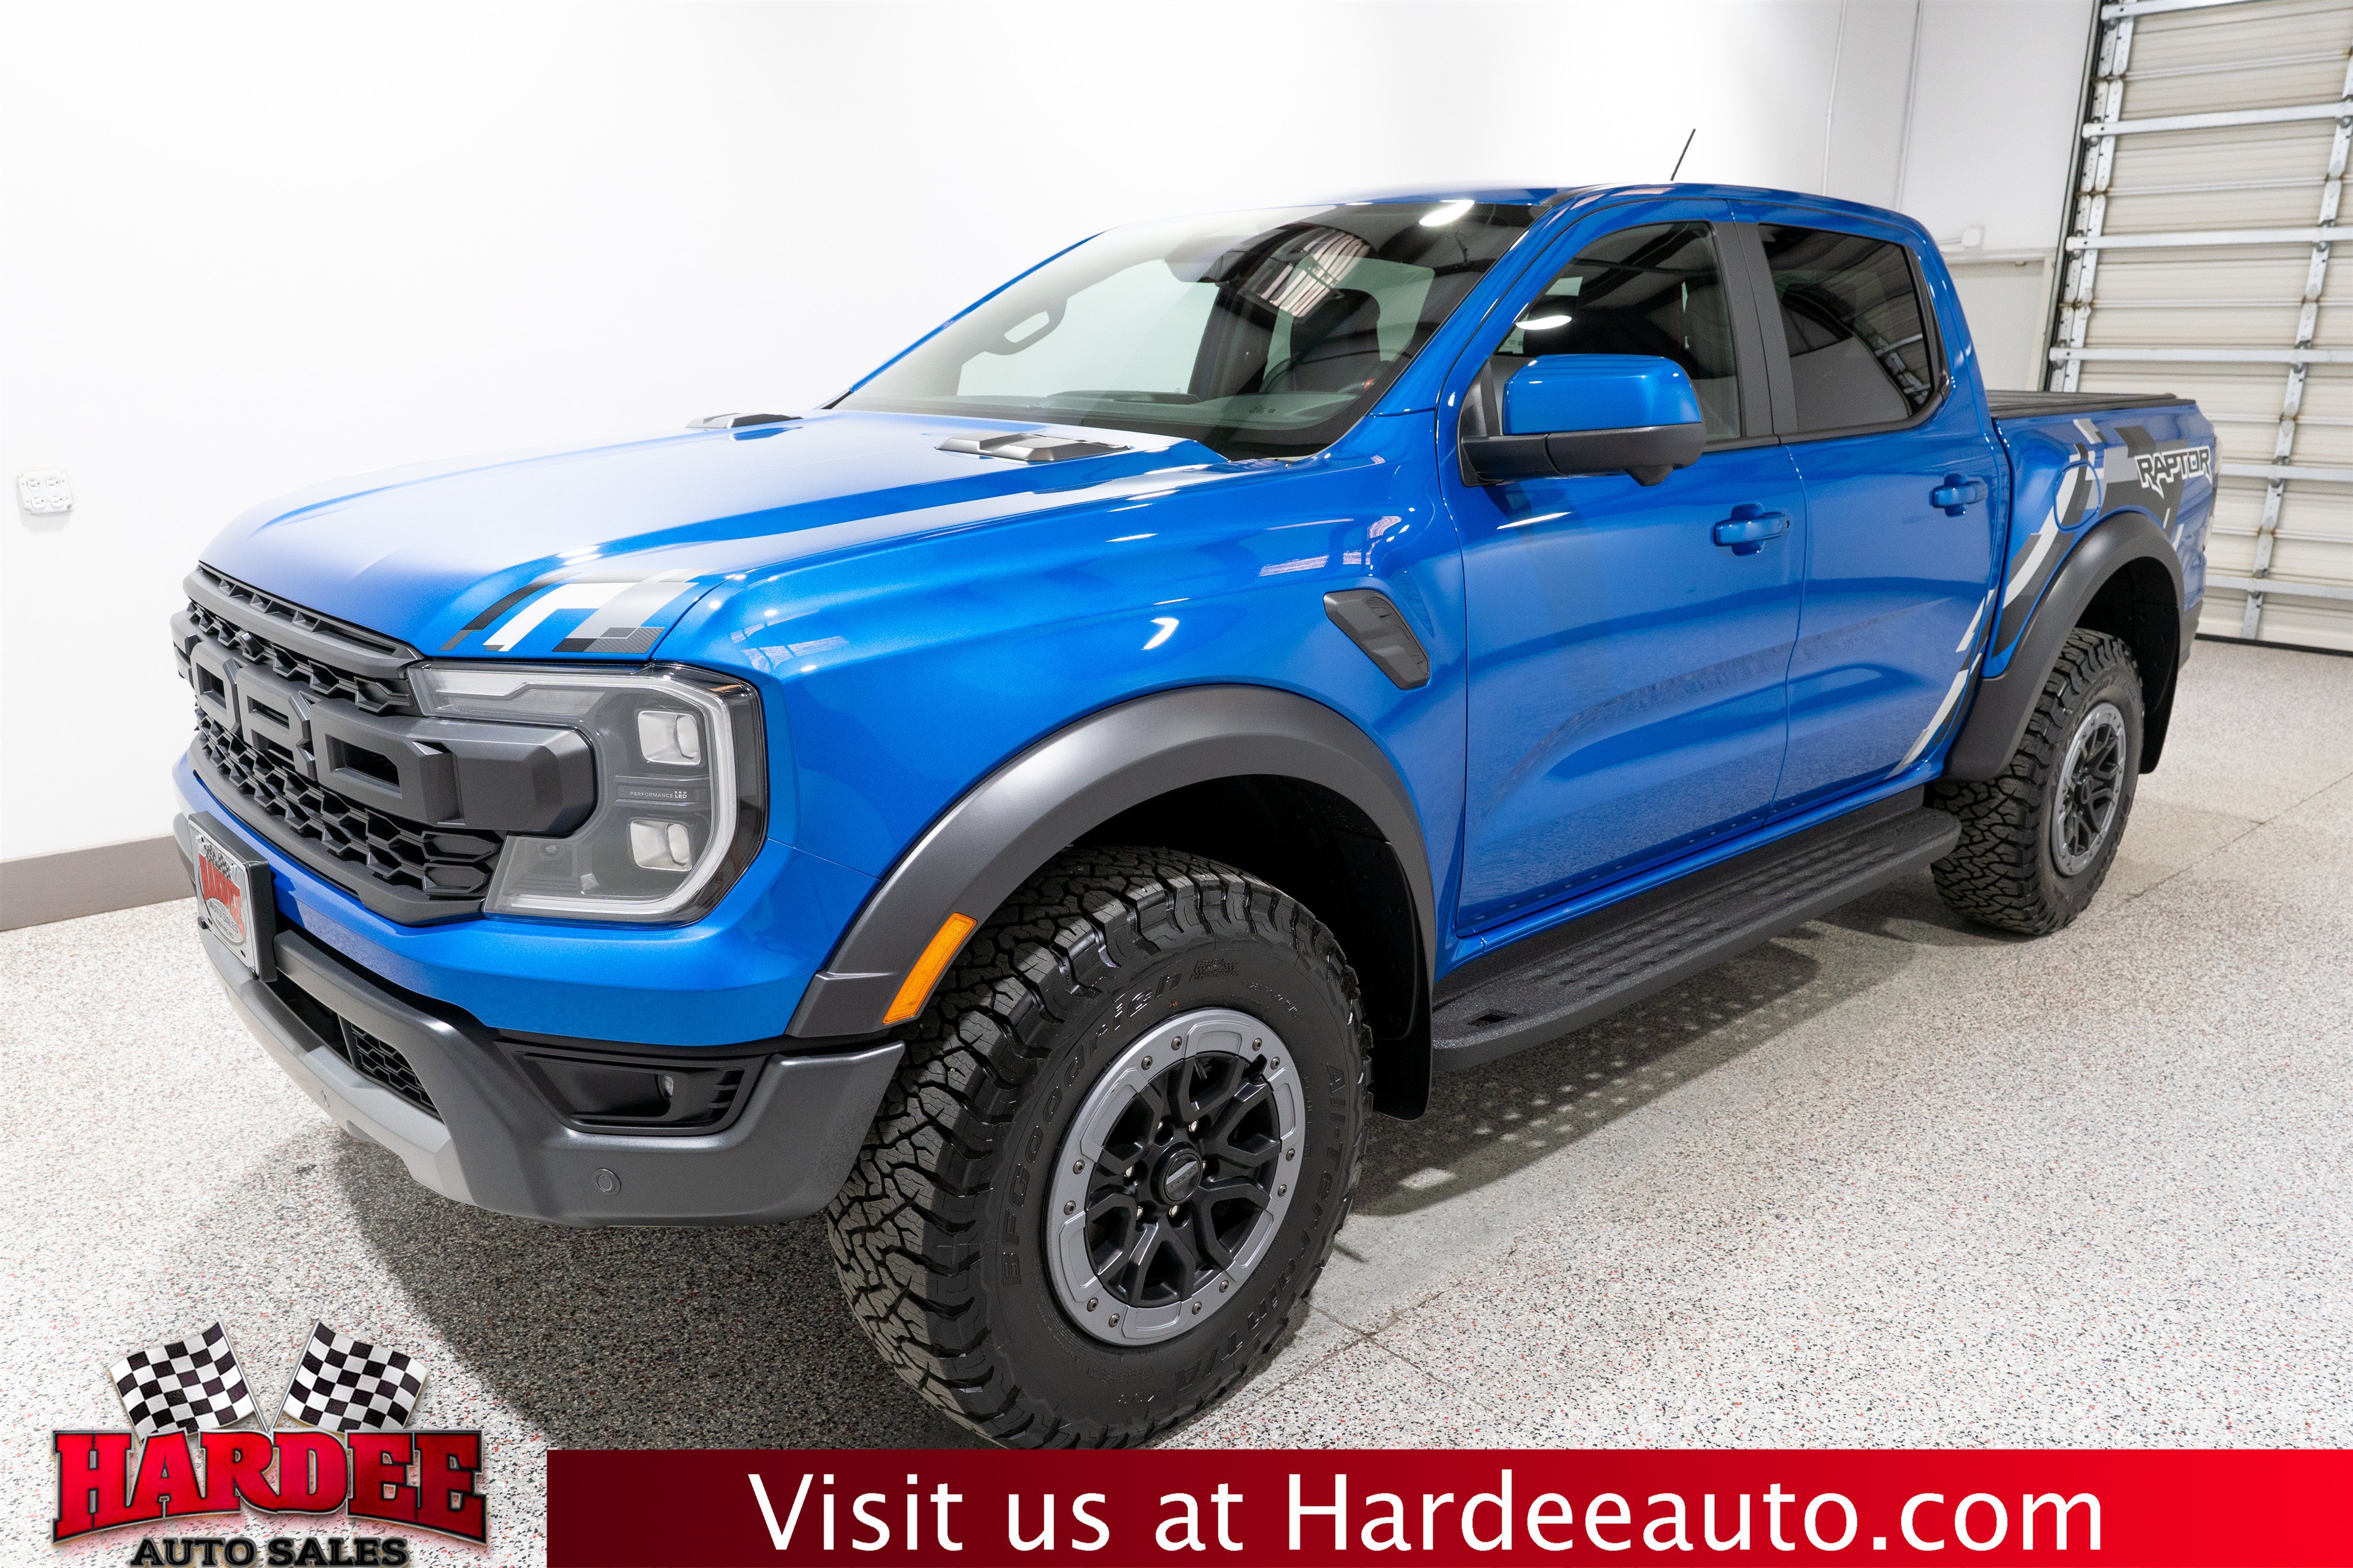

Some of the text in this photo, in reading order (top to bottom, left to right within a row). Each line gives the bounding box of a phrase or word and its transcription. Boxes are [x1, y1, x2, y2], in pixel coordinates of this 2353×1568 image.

[2134, 445, 2213, 499] RAPTOR
[674, 791, 688, 799] LED
[210, 900, 239, 934] AUTO SALES
[1001, 971, 1182, 1287] BFGoodrich
[1171, 1167, 1196, 1188] FORD
[1247, 1063, 1347, 1331] All-Terrain
